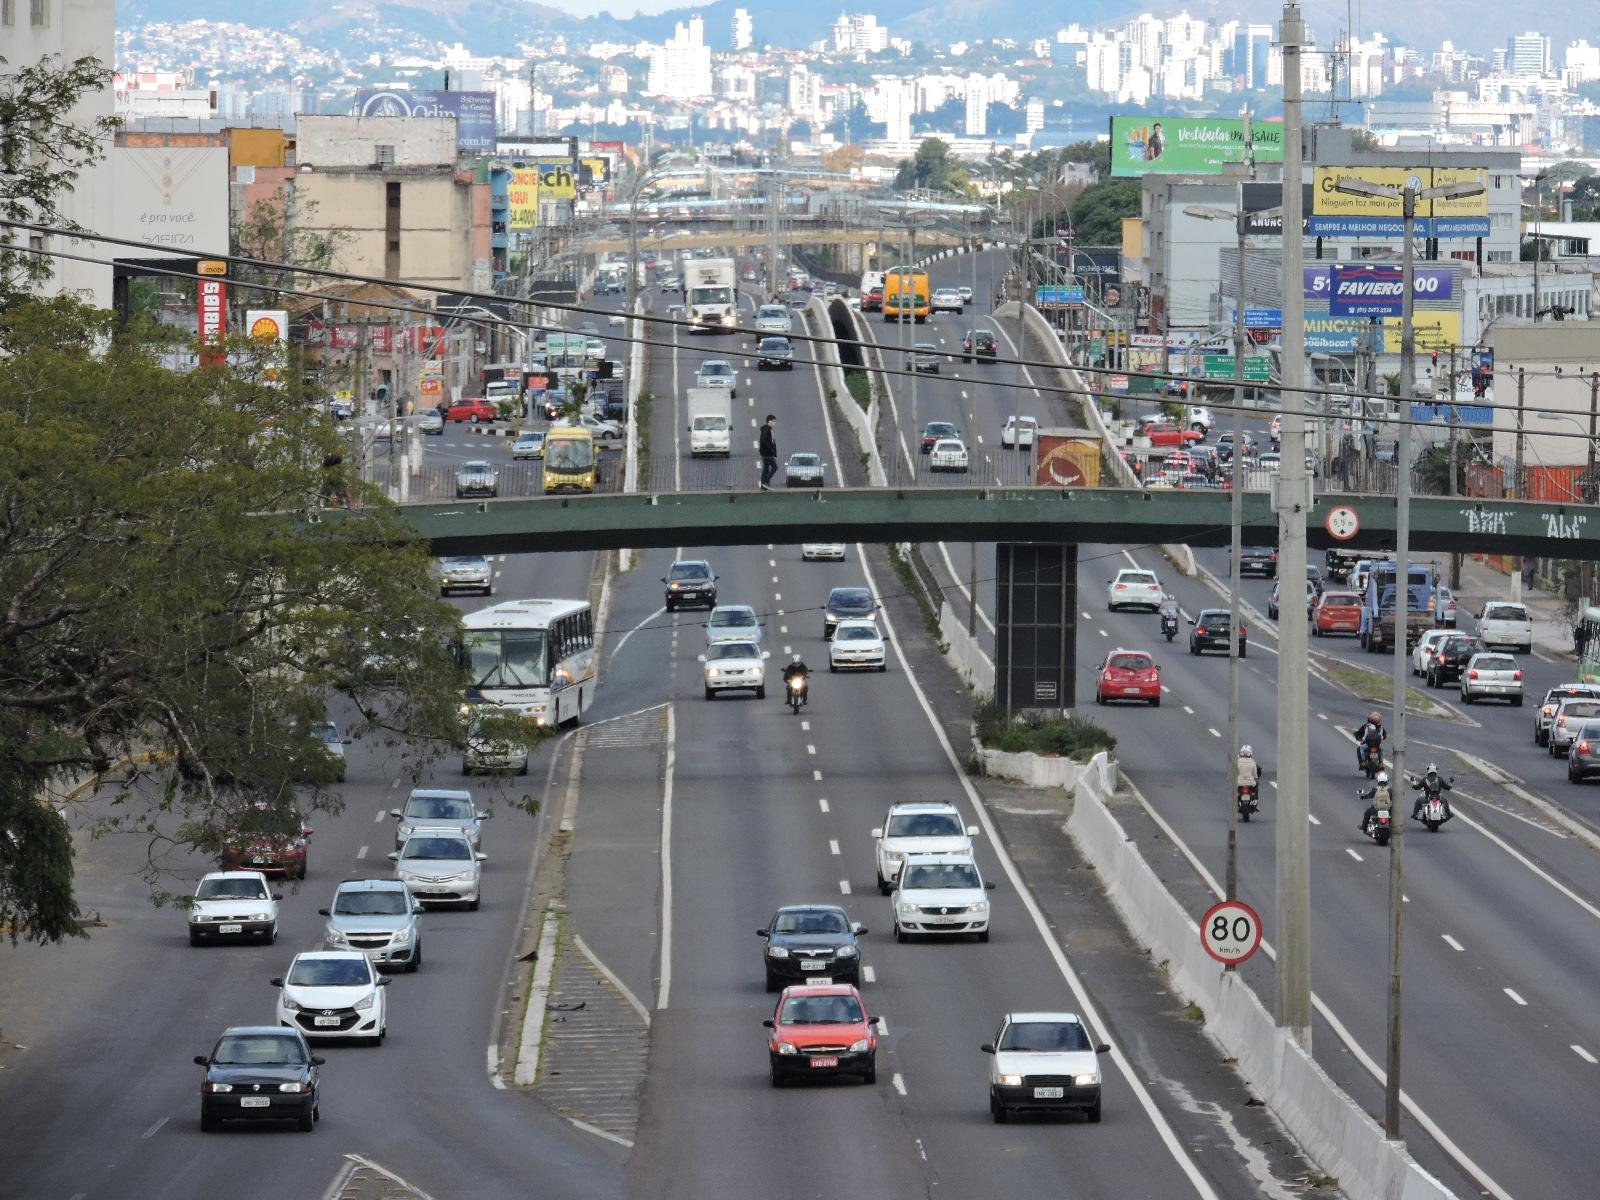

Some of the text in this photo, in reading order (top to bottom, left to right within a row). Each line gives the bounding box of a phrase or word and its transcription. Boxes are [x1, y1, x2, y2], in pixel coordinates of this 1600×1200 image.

[1178, 126, 1230, 142] Vestibular
[538, 167, 571, 187] ch
[1321, 198, 1353, 209] Ninguém
[1355, 198, 1367, 207] faz
[1369, 200, 1387, 208] mais
[1314, 221, 1426, 233] SEMPRE A MELHOR NEGOCIÃO.
[1413, 277, 1438, 292] 00
[1211, 916, 1251, 942] 80
[1219, 945, 1241, 954] km/h
